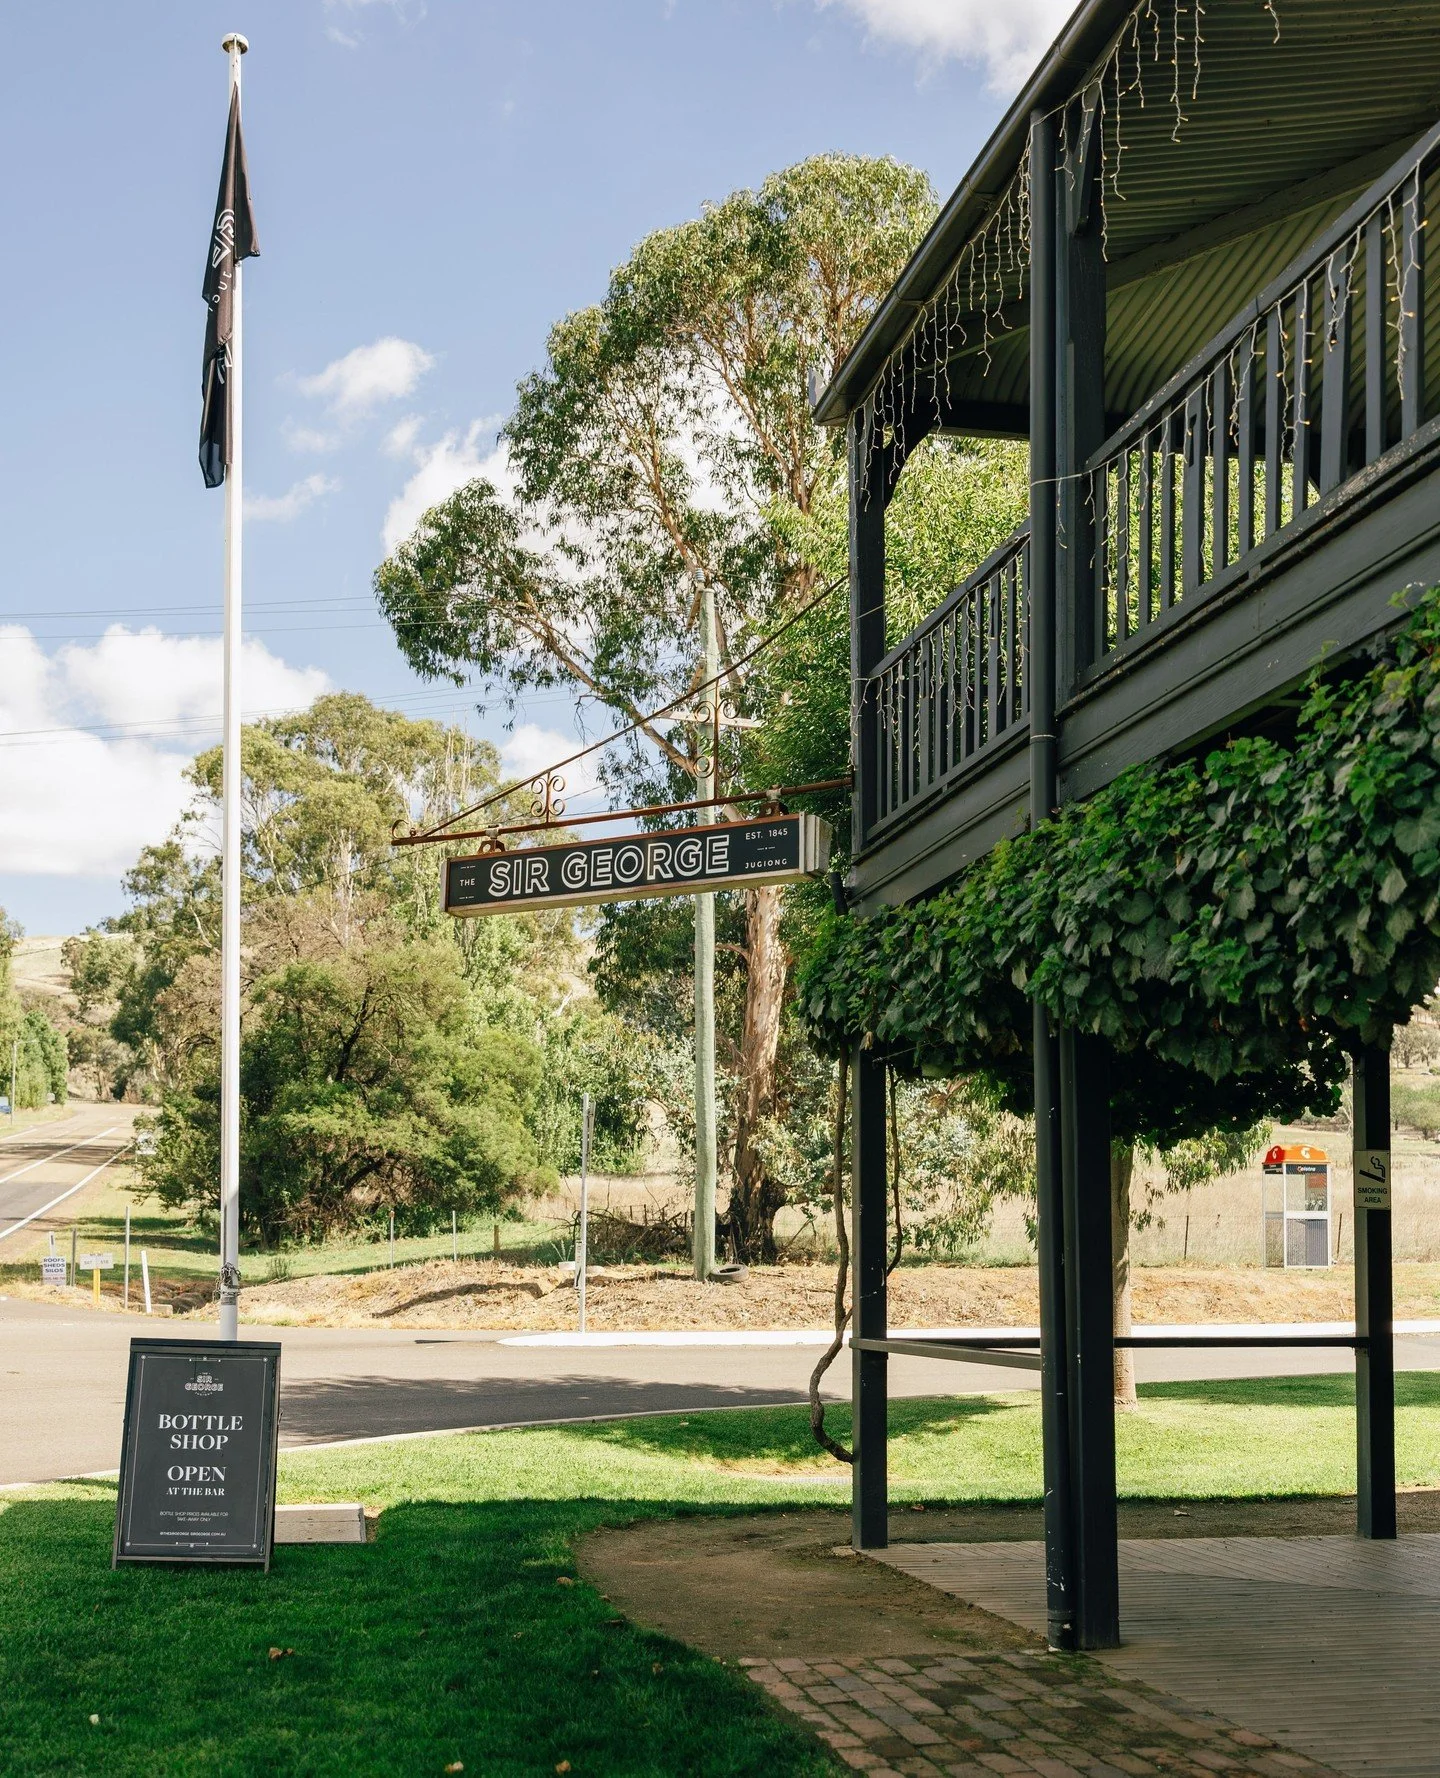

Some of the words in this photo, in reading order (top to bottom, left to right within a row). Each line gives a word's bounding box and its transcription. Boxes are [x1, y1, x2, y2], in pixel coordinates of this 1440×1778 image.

[745, 830, 763, 840] EST.
[768, 827, 788, 838] 1845
[487, 856, 550, 898] SIR
[561, 834, 731, 890] GEORGE
[744, 857, 788, 870] JUGIONG
[459, 877, 476, 887] THE
[1364, 1196, 1382, 1204] AREA
[196, 1375, 213, 1383] SIR
[184, 1382, 224, 1391] GEORGE
[158, 1414, 243, 1431] BOTTLE
[170, 1433, 229, 1450] SHOP
[167, 1465, 227, 1482] OPEN
[166, 1487, 180, 1495] AT
[182, 1487, 203, 1496] THE
[204, 1487, 225, 1496] BAR
